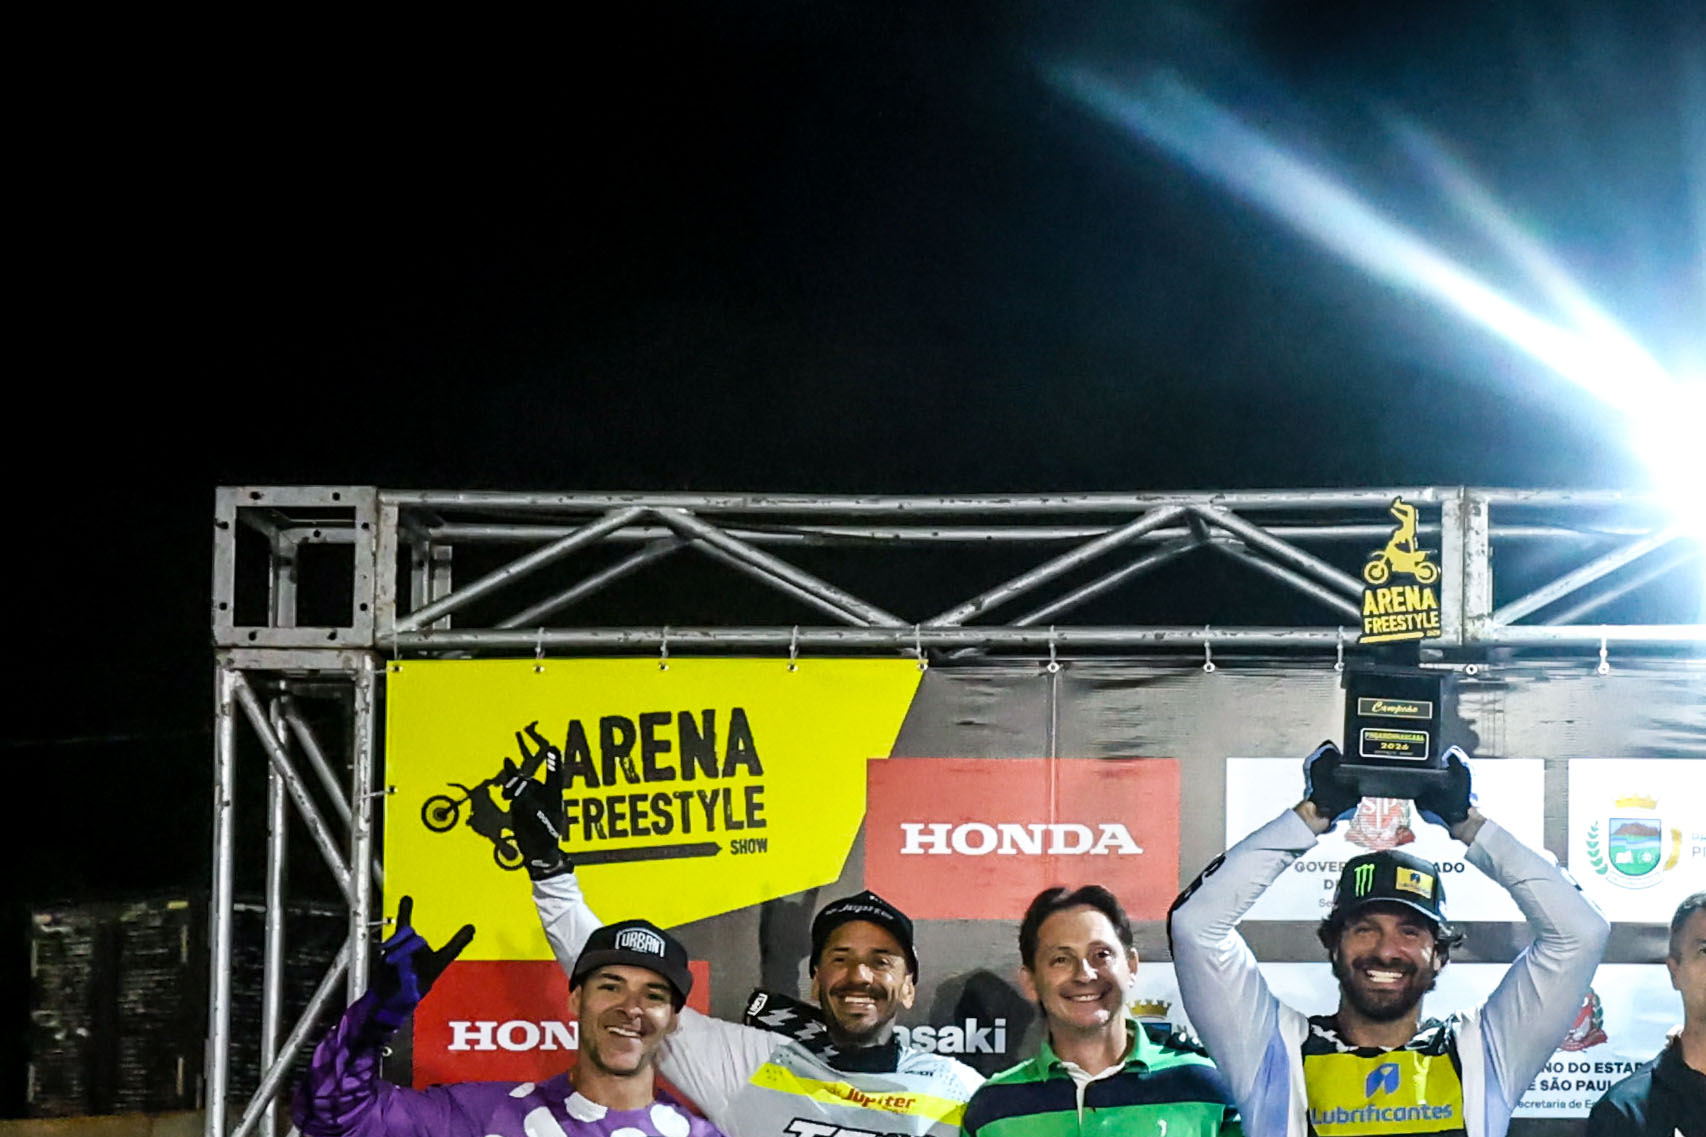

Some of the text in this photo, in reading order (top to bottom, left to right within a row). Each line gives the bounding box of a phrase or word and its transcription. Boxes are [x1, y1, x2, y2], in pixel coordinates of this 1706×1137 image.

[1363, 585, 1438, 615] ARENA
[1364, 611, 1440, 633] FREESTYLE
[563, 707, 765, 789] ARENA
[562, 786, 767, 842] FREESTYLE
[731, 838, 768, 856] SHOW
[900, 823, 1143, 855] HONDA
[621, 931, 660, 954] URBAN
[448, 1021, 579, 1051] HON
[892, 1018, 1006, 1053] asaki
[1568, 1062, 1591, 1073] DO
[1541, 1077, 1572, 1091] SÃO
[1311, 1104, 1453, 1125] Lubrificantes
[1518, 1098, 1566, 1109] ecretaria
